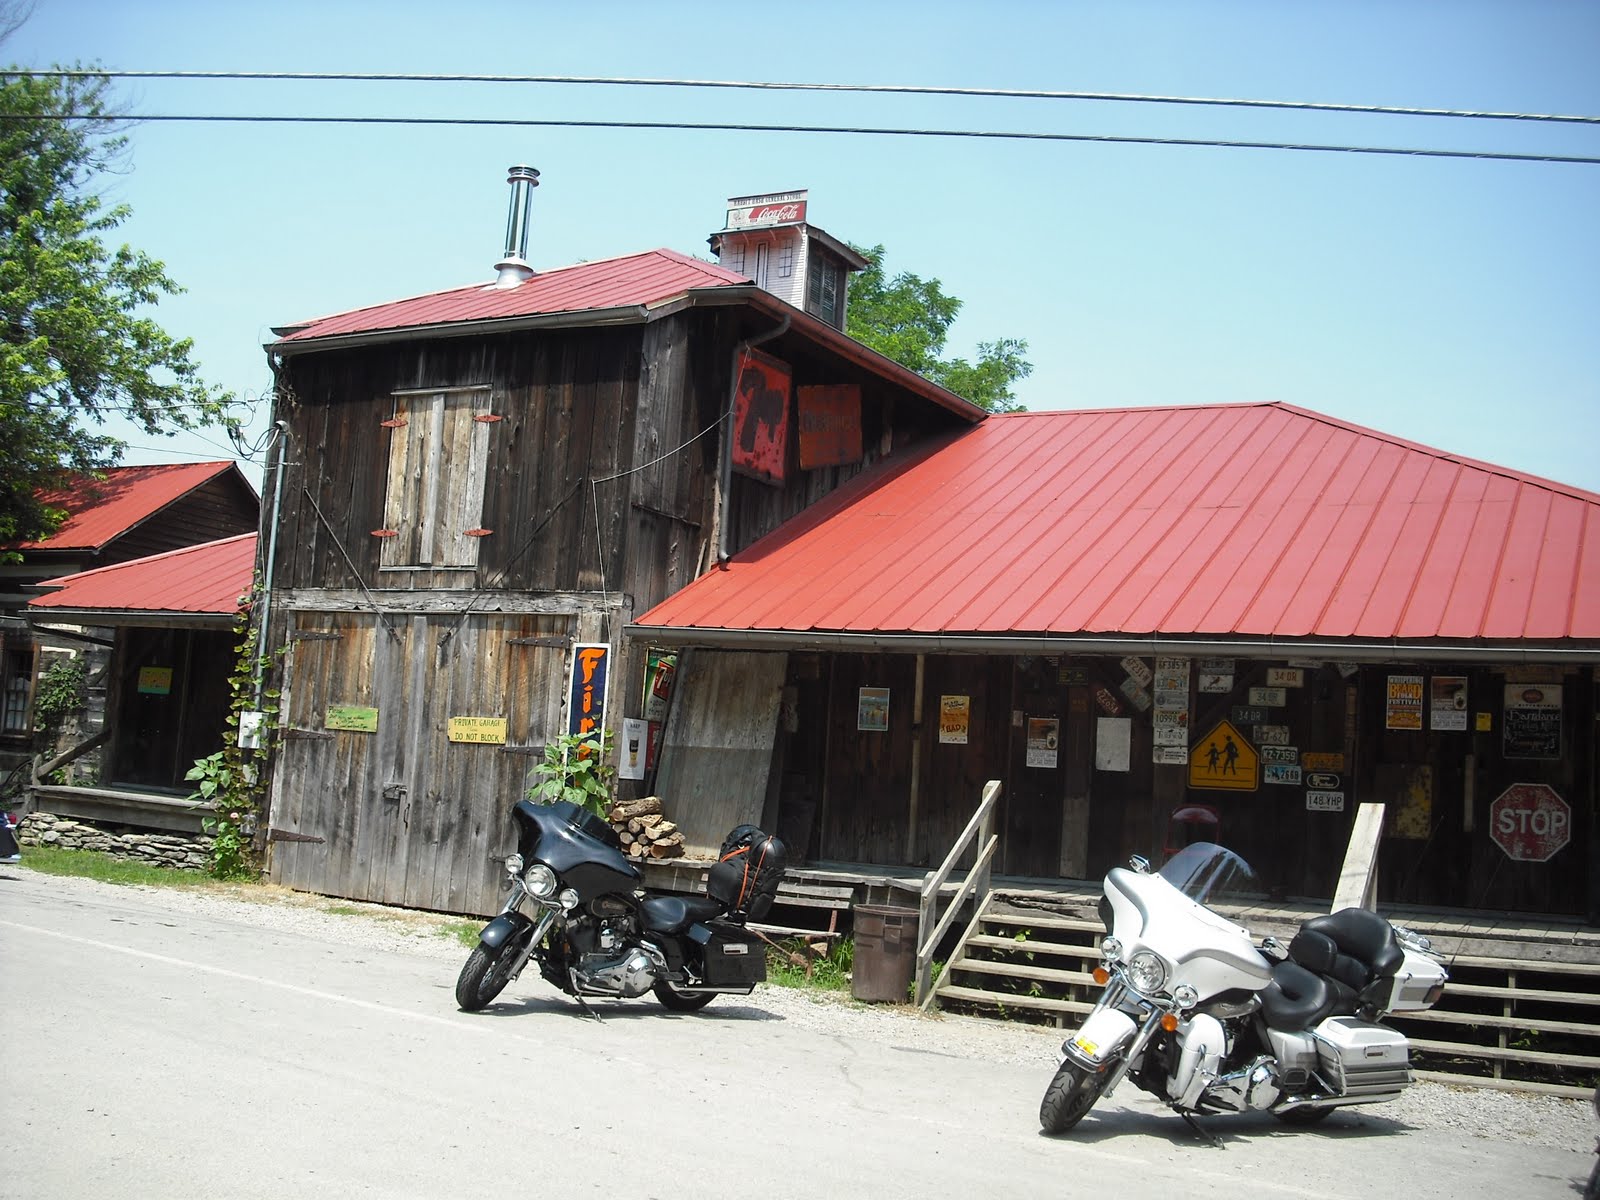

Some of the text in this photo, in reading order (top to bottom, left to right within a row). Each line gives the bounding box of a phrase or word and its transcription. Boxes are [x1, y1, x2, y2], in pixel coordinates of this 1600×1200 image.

[1390, 683, 1421, 699] BEARD
[454, 718, 477, 727] PRIVATE
[454, 732, 501, 744] DO NOT BLOCK
[1498, 808, 1567, 836] STOP
